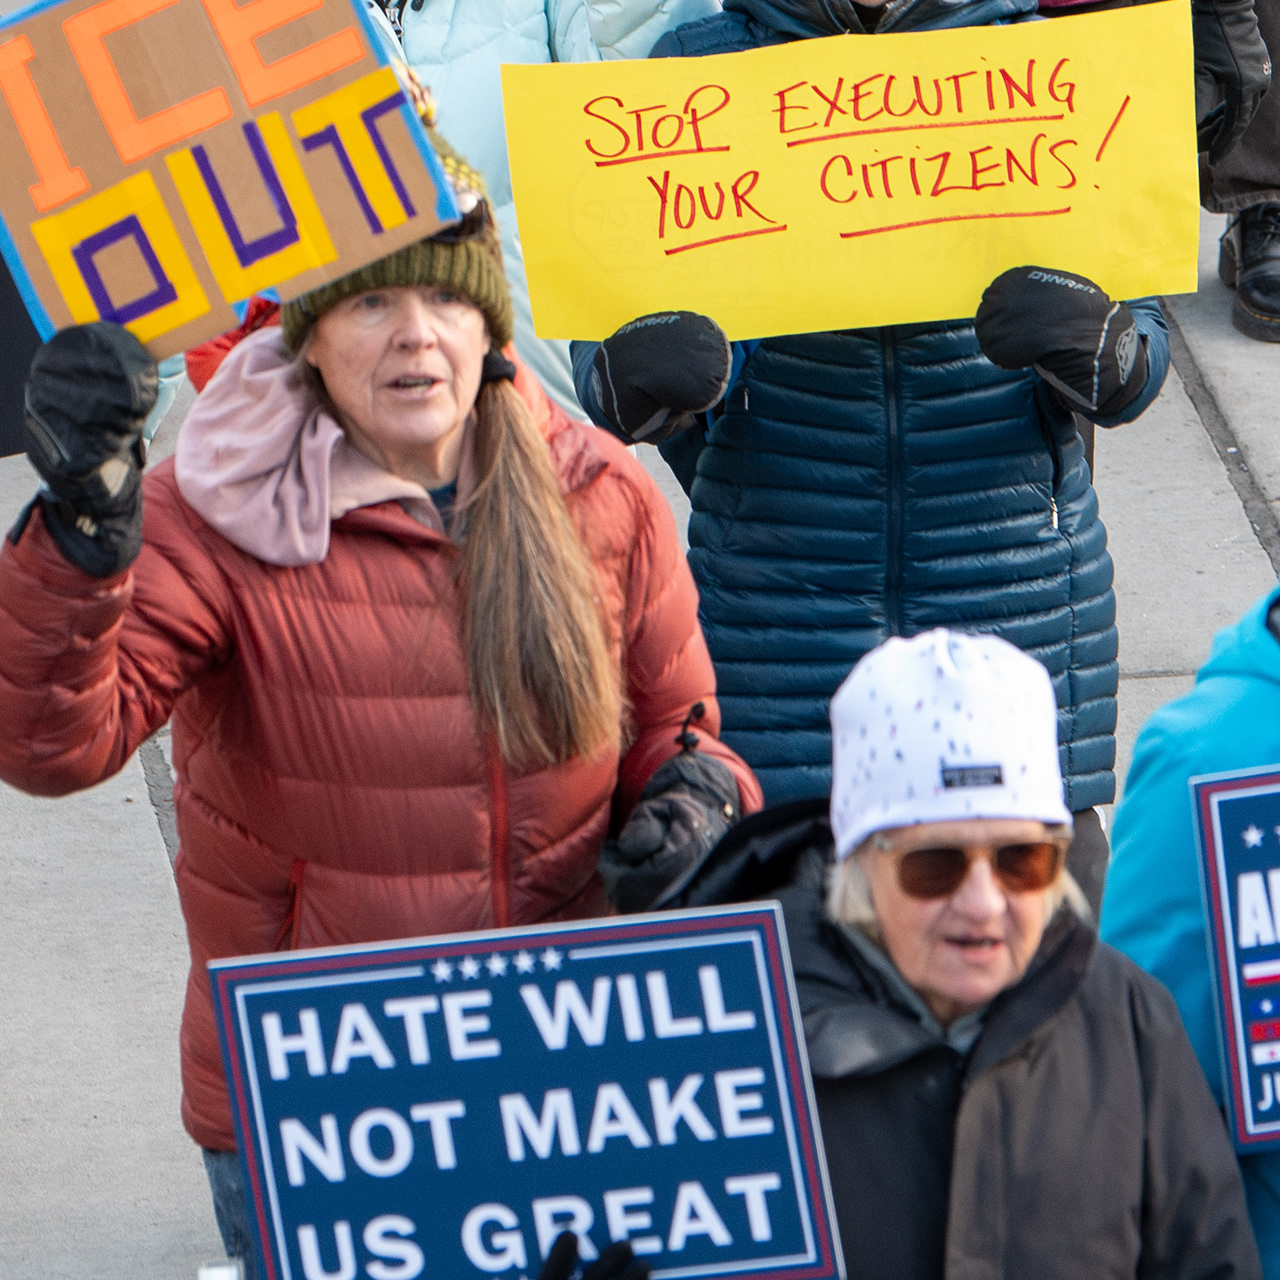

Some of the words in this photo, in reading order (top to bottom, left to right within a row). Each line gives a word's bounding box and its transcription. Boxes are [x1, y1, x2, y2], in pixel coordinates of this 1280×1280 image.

[584, 84, 731, 159] STOP
[29, 66, 418, 344] OUT
[646, 170, 771, 239] YOUR
[261, 990, 501, 1081] HATE
[520, 965, 755, 1051] WILL
[280, 1099, 466, 1187] NOT
[499, 1068, 774, 1162] MAKE
[297, 1214, 424, 1280] US
[461, 1173, 781, 1274] GREAT
